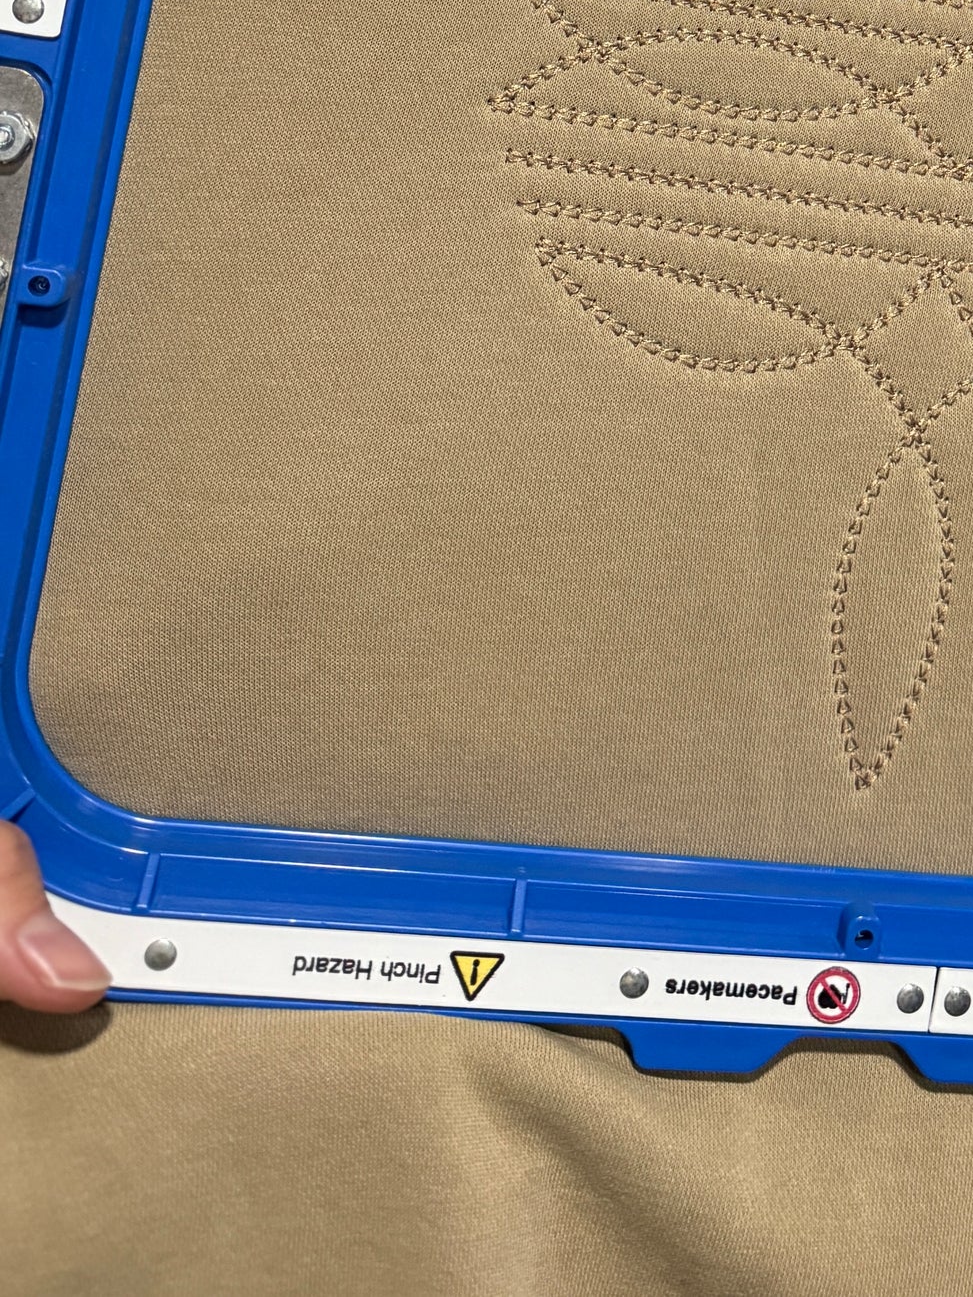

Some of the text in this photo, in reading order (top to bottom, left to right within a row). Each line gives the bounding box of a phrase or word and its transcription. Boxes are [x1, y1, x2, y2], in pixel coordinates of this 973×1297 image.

[291, 954, 442, 985] Pinch Hazard
[664, 977, 798, 1006] Pacemakers
